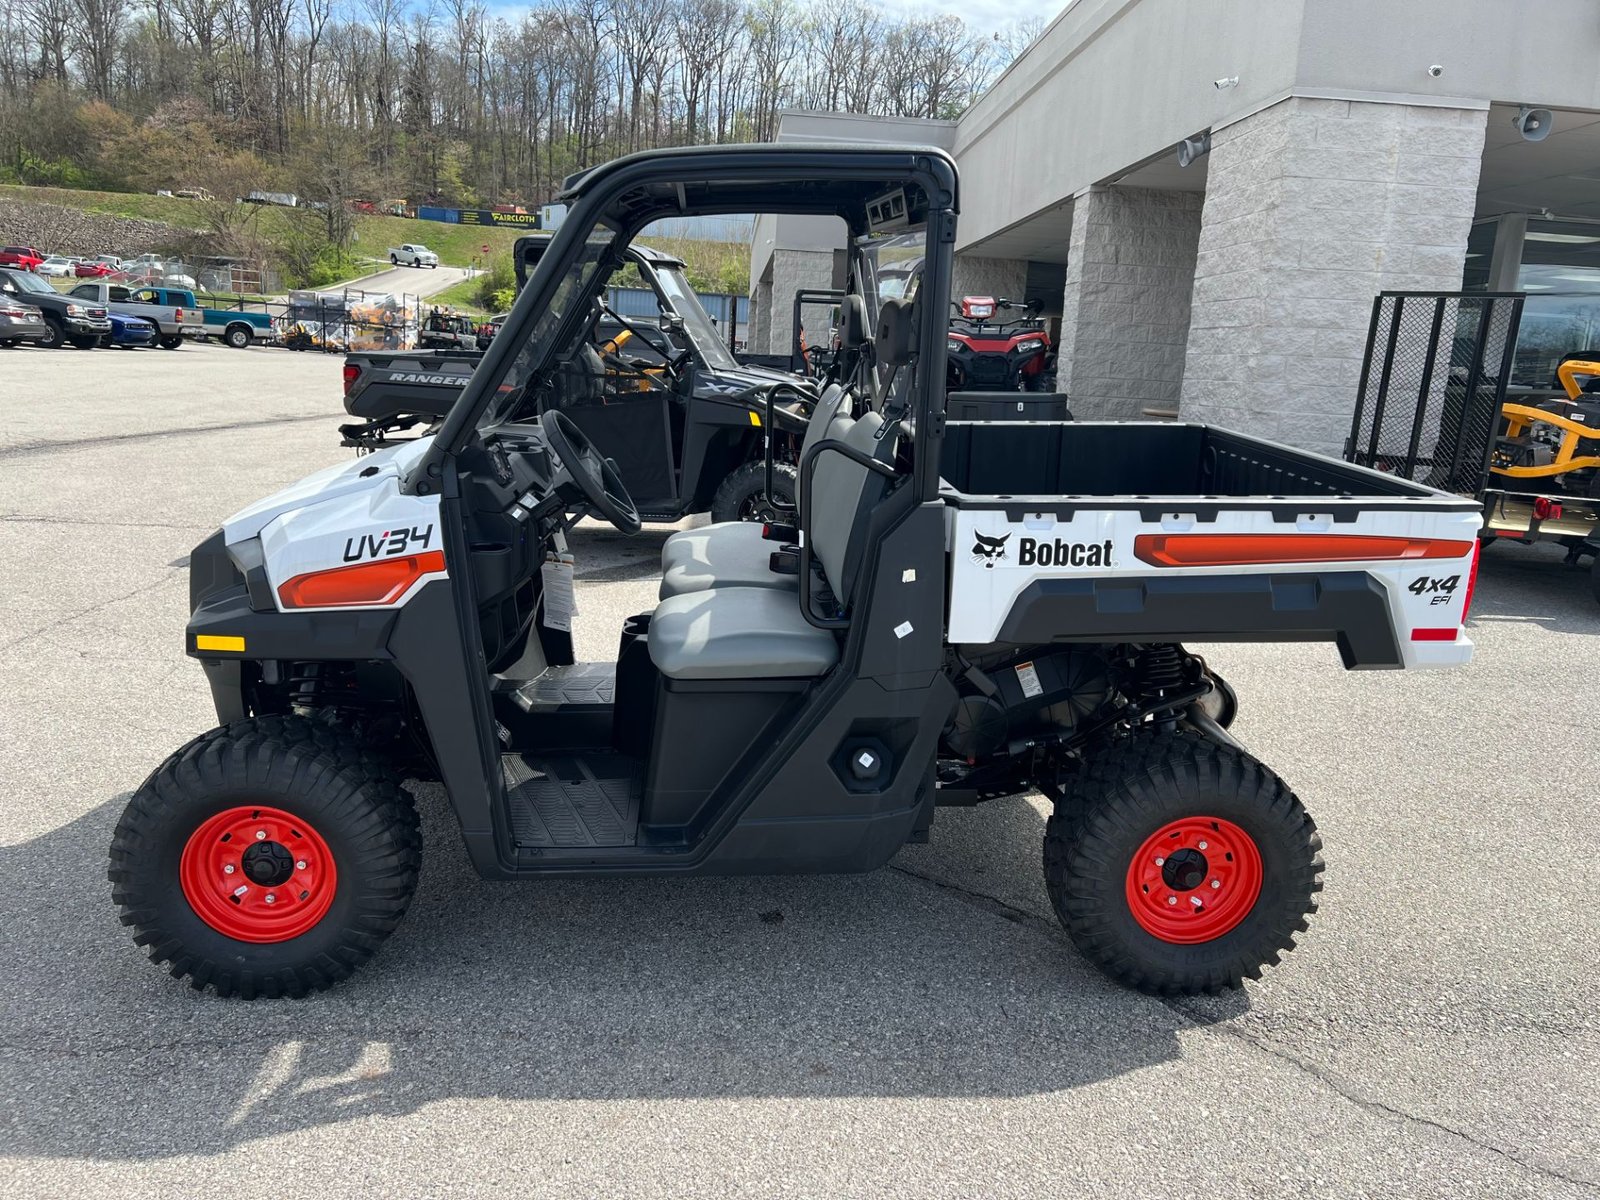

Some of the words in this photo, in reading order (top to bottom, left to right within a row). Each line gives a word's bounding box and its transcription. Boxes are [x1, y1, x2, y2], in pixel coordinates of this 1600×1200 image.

[491, 213, 535, 223] FAIRCLOTH
[389, 373, 470, 386] RANGER
[343, 523, 433, 562] UV34
[1018, 538, 1113, 567] Bobcat
[1408, 575, 1461, 595] 4x4
[1430, 596, 1451, 605] EFI
